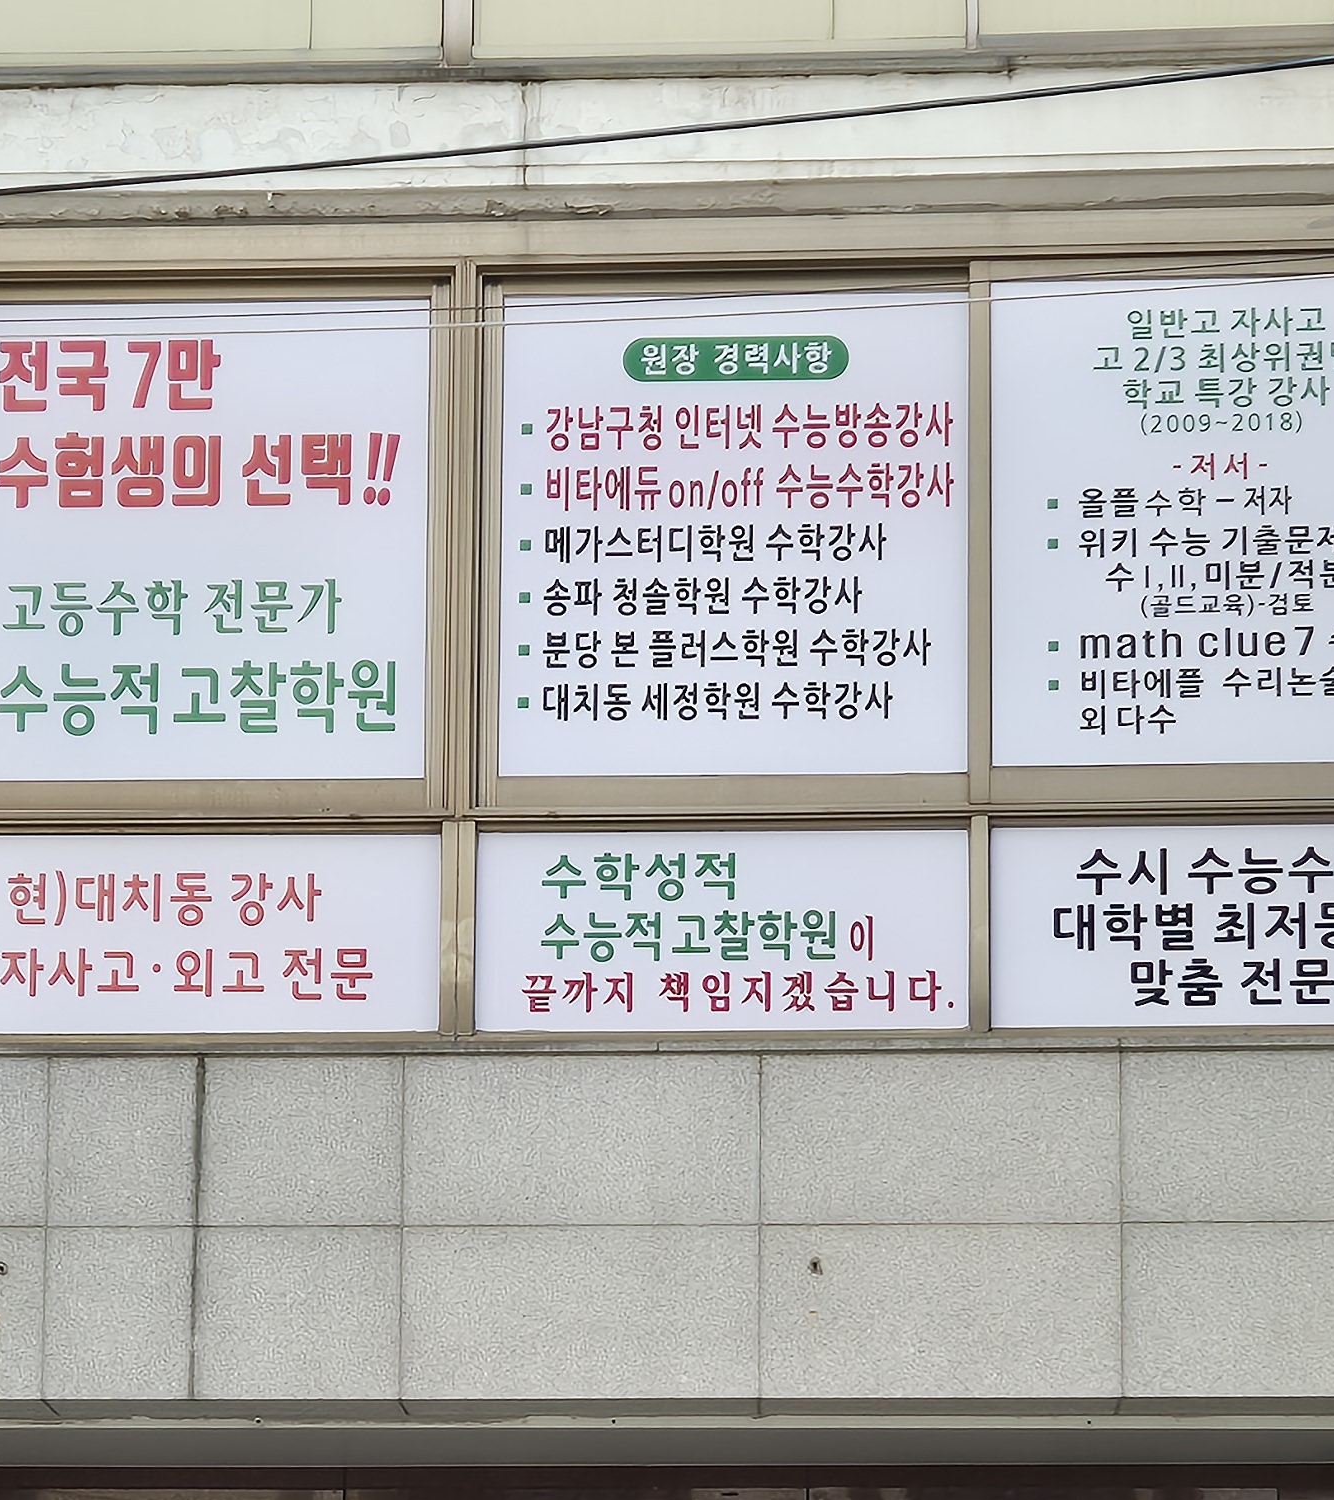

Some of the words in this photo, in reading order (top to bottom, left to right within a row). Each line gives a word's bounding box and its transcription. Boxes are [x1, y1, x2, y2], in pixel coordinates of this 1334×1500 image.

[1128, 309, 1220, 339] 일반고
[1231, 307, 1325, 337] 자사고
[0, 341, 108, 412] 전국
[128, 340, 221, 410] 7만
[640, 343, 700, 376] 원장
[714, 340, 833, 375] 경력사항
[1093, 347, 1122, 369] 고
[1134, 346, 1185, 373] 2/3
[1123, 379, 1184, 409] 학교
[1195, 378, 1257, 408] 특강
[1269, 376, 1330, 407] 강사
[547, 405, 661, 451] 강남구청
[676, 404, 761, 449] 인터넷
[772, 402, 953, 448] 수능방송강사
[1141, 411, 1302, 435] (2009~2018)
[242, 433, 400, 506] 선택!!
[776, 462, 954, 508] 수능수학강사
[1079, 487, 1206, 518] 올플수학
[1244, 485, 1292, 515] 저자
[545, 524, 753, 563] 메가스터디학원
[766, 523, 887, 561] 수학강사
[1079, 528, 1136, 558] 위키
[1150, 528, 1210, 557] 수능
[3, 580, 188, 637] 고등수학
[204, 579, 342, 634] 전문가
[544, 578, 602, 616] 송파
[613, 577, 729, 616] 청솔학원
[742, 576, 862, 614] 수학강사
[543, 631, 601, 668] 분당
[611, 631, 638, 667] 본
[649, 629, 797, 668] 플러스학원
[810, 628, 931, 666] 수학강사
[1081, 629, 1181, 659] math
[543, 684, 631, 721] 대치동
[642, 682, 759, 720] 세정학원
[772, 681, 893, 719] 수학강사
[1082, 668, 1204, 699] 비타에플
[1080, 705, 1105, 735] 외
[1118, 705, 1176, 734] 다수
[542, 853, 735, 901] 수학성적
[1077, 848, 1167, 895] 수시
[8, 871, 212, 926] 현)대치동
[232, 873, 322, 926] 강사
[1054, 903, 1194, 951] 대학별
[283, 948, 373, 1000] 전문
[522, 972, 633, 1013] 끝까지
[659, 970, 953, 1012] 책임지겠습니다.
[1131, 959, 1223, 1006] 맞춤
[1241, 958, 1334, 1005] 전문
